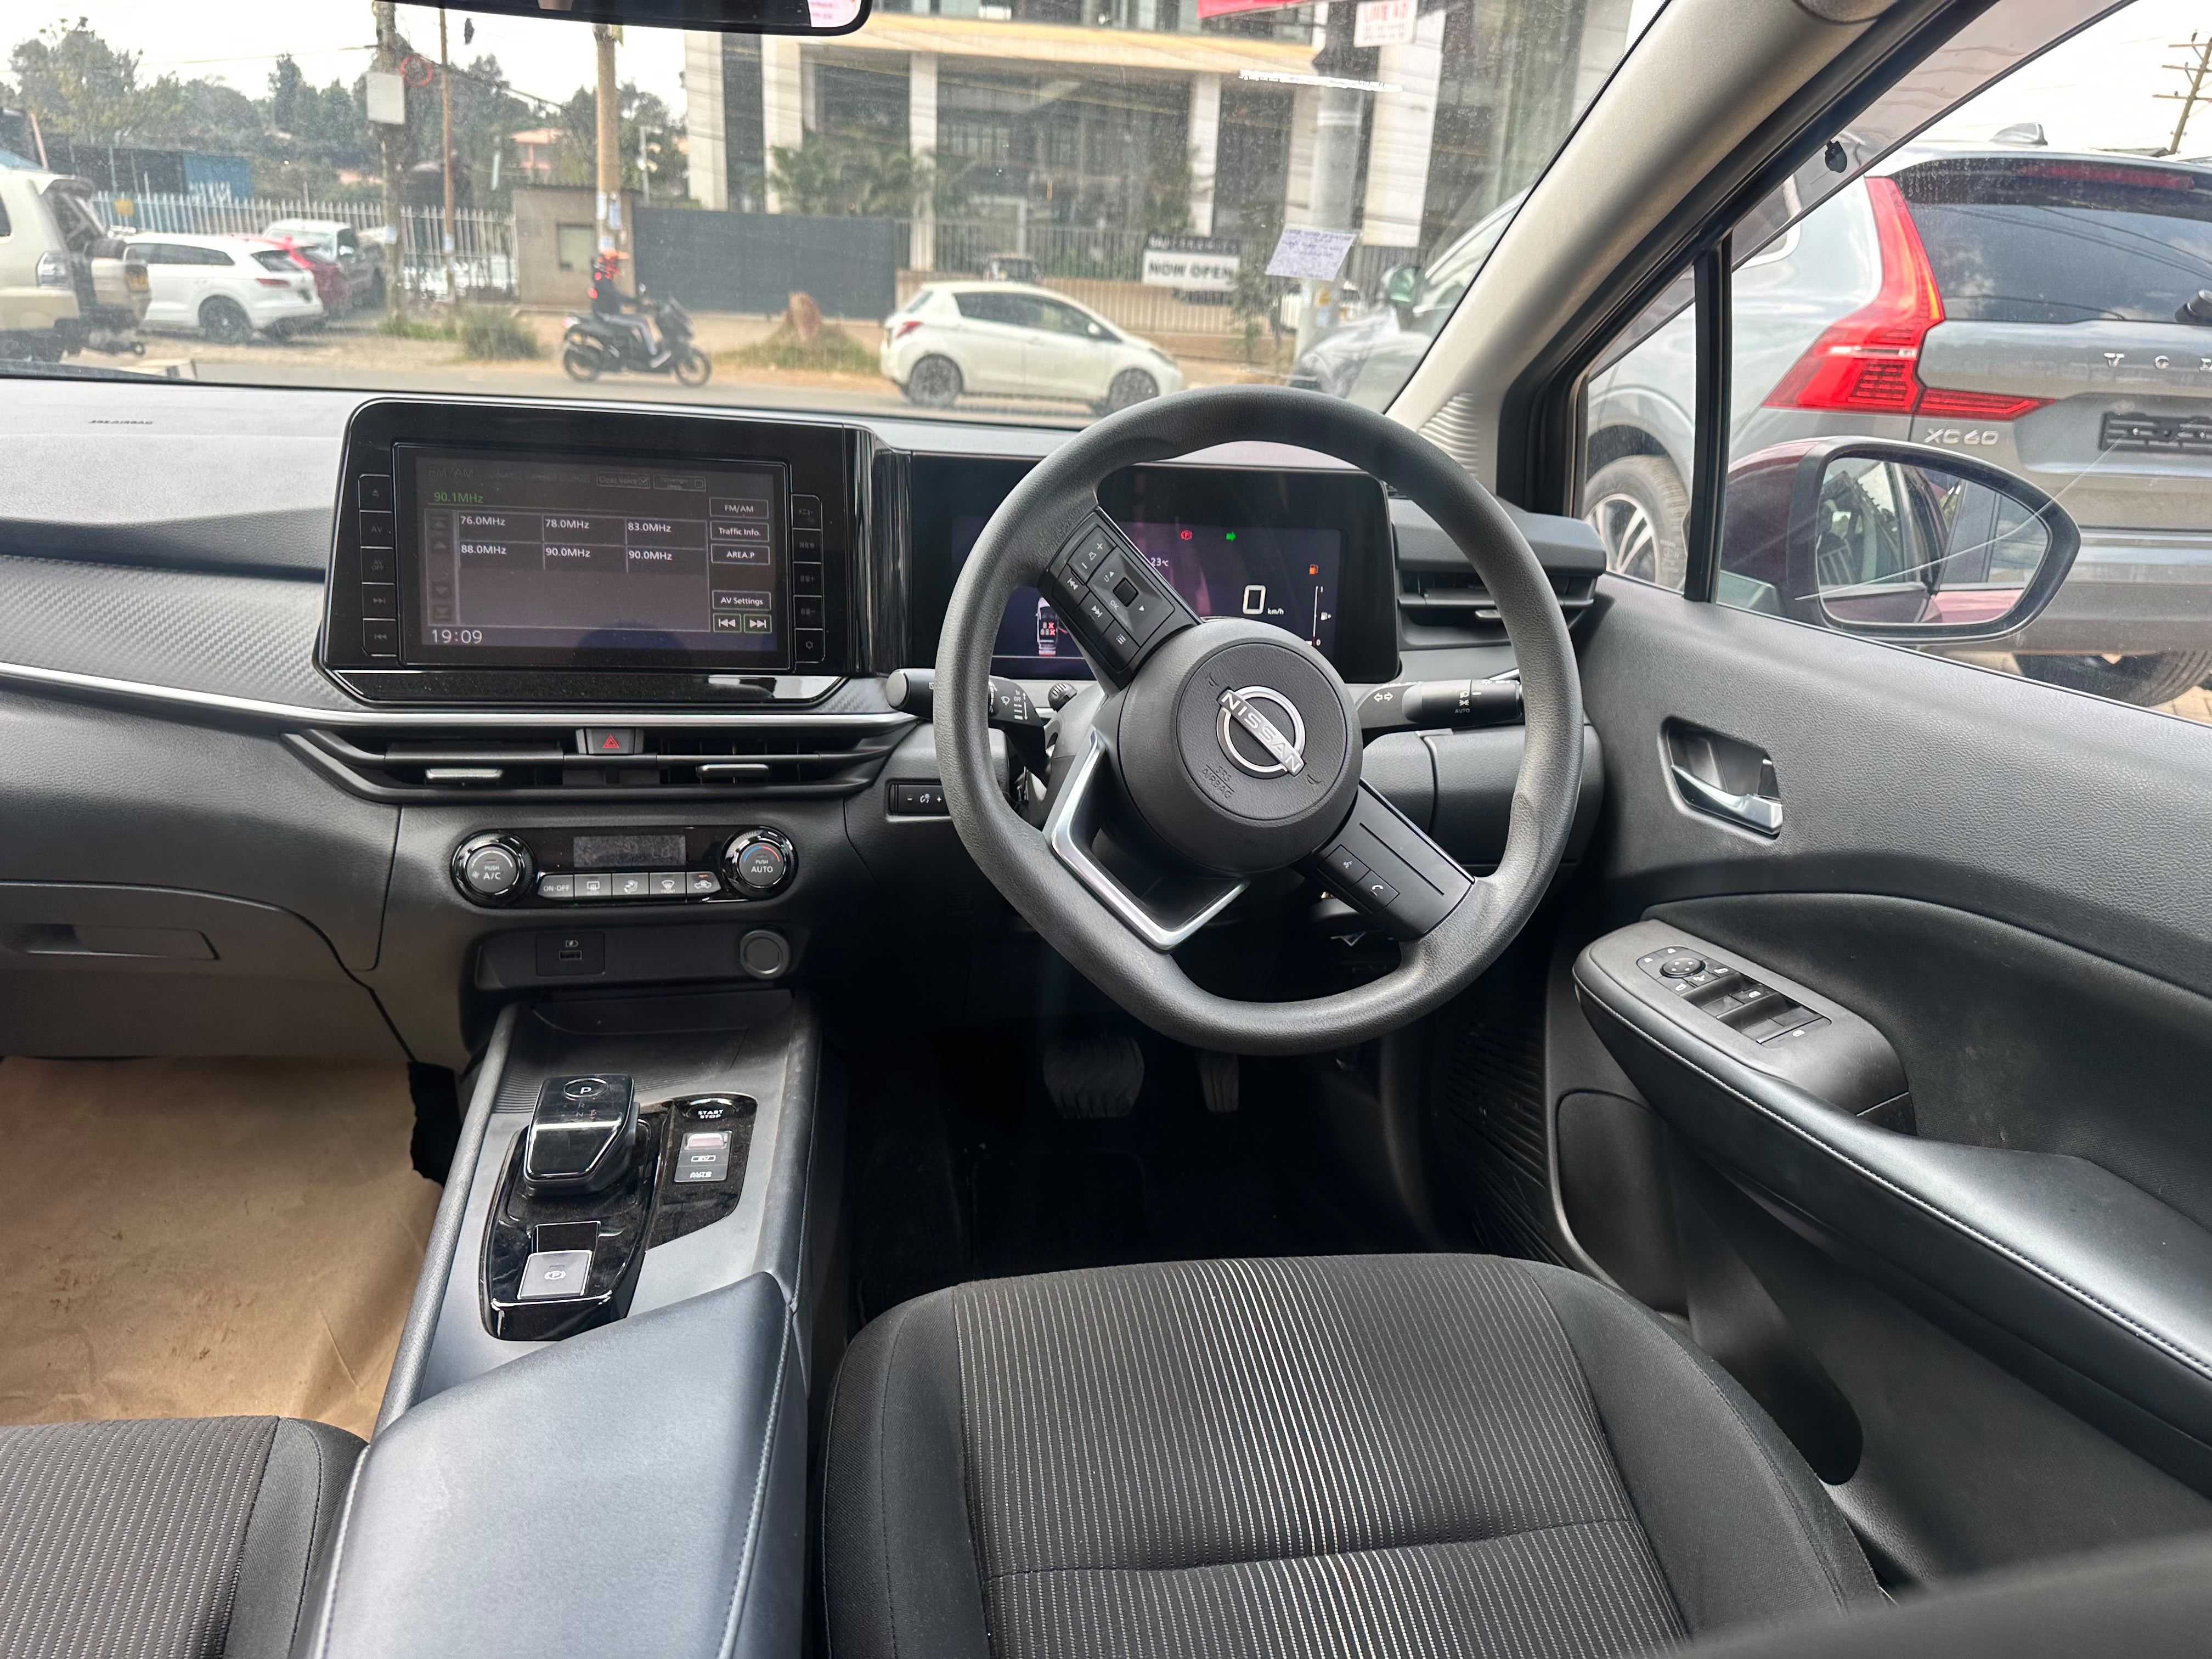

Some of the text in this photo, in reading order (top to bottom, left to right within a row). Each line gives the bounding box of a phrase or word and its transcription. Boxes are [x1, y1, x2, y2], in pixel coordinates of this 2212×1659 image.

[1925, 429, 1999, 445] XC60
[434, 492, 483, 504] 90.1MHz
[725, 504, 754, 513] FM/AM
[460, 516, 506, 526] 76.0MHz
[545, 518, 590, 529] 78.0MHz
[628, 523, 672, 533] 83.0MHz
[719, 527, 761, 536] Traffic Info.
[461, 545, 507, 555] 88.0MHz
[546, 548, 591, 558] 90.0MHz
[629, 550, 673, 561] 90.0MHz
[726, 551, 755, 559] AREA.P
[733, 597, 764, 606] Settings
[1243, 585, 1266, 614] 0
[1110, 600, 1119, 611] OK
[431, 629, 483, 644] 19:09
[1221, 692, 1303, 772] NISSAN
[1215, 766, 1232, 782] SRS
[1200, 769, 1233, 798] AIRBAG
